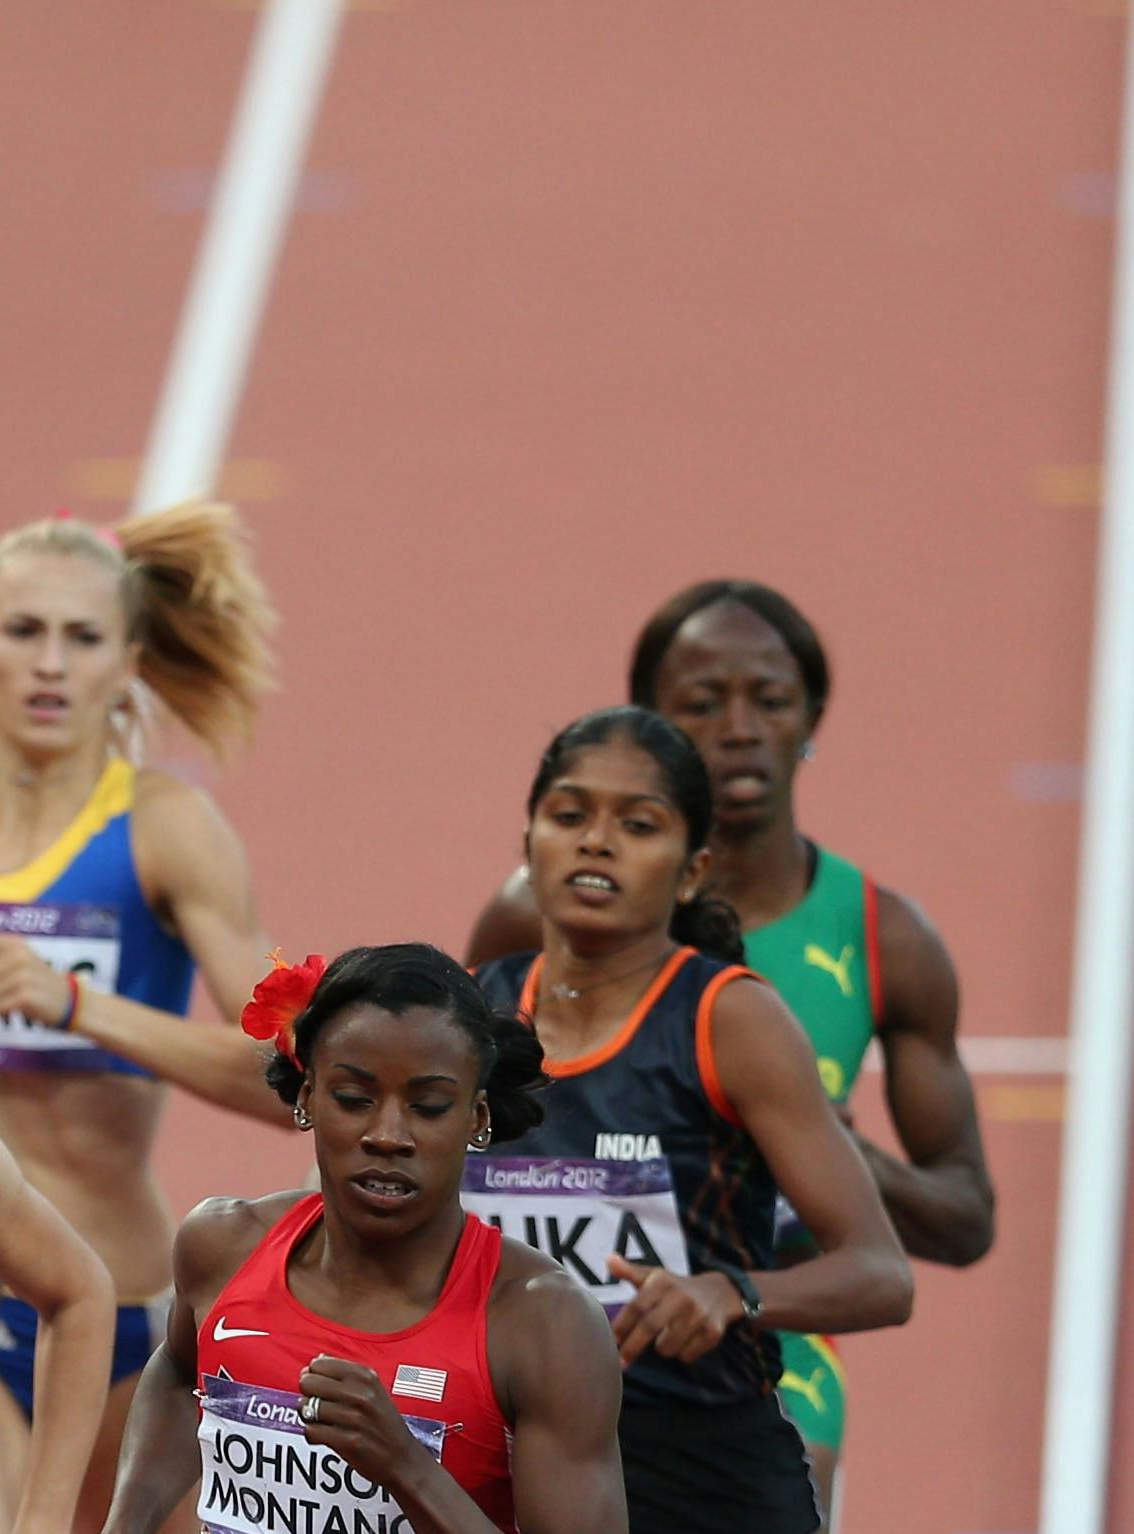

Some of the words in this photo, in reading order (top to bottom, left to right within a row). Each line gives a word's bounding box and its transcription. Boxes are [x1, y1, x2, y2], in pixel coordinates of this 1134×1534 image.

[594, 1133, 662, 1161] INDIA
[484, 1165, 558, 1188] London
[561, 1166, 609, 1190] 2012
[246, 1394, 306, 1427] Lond
